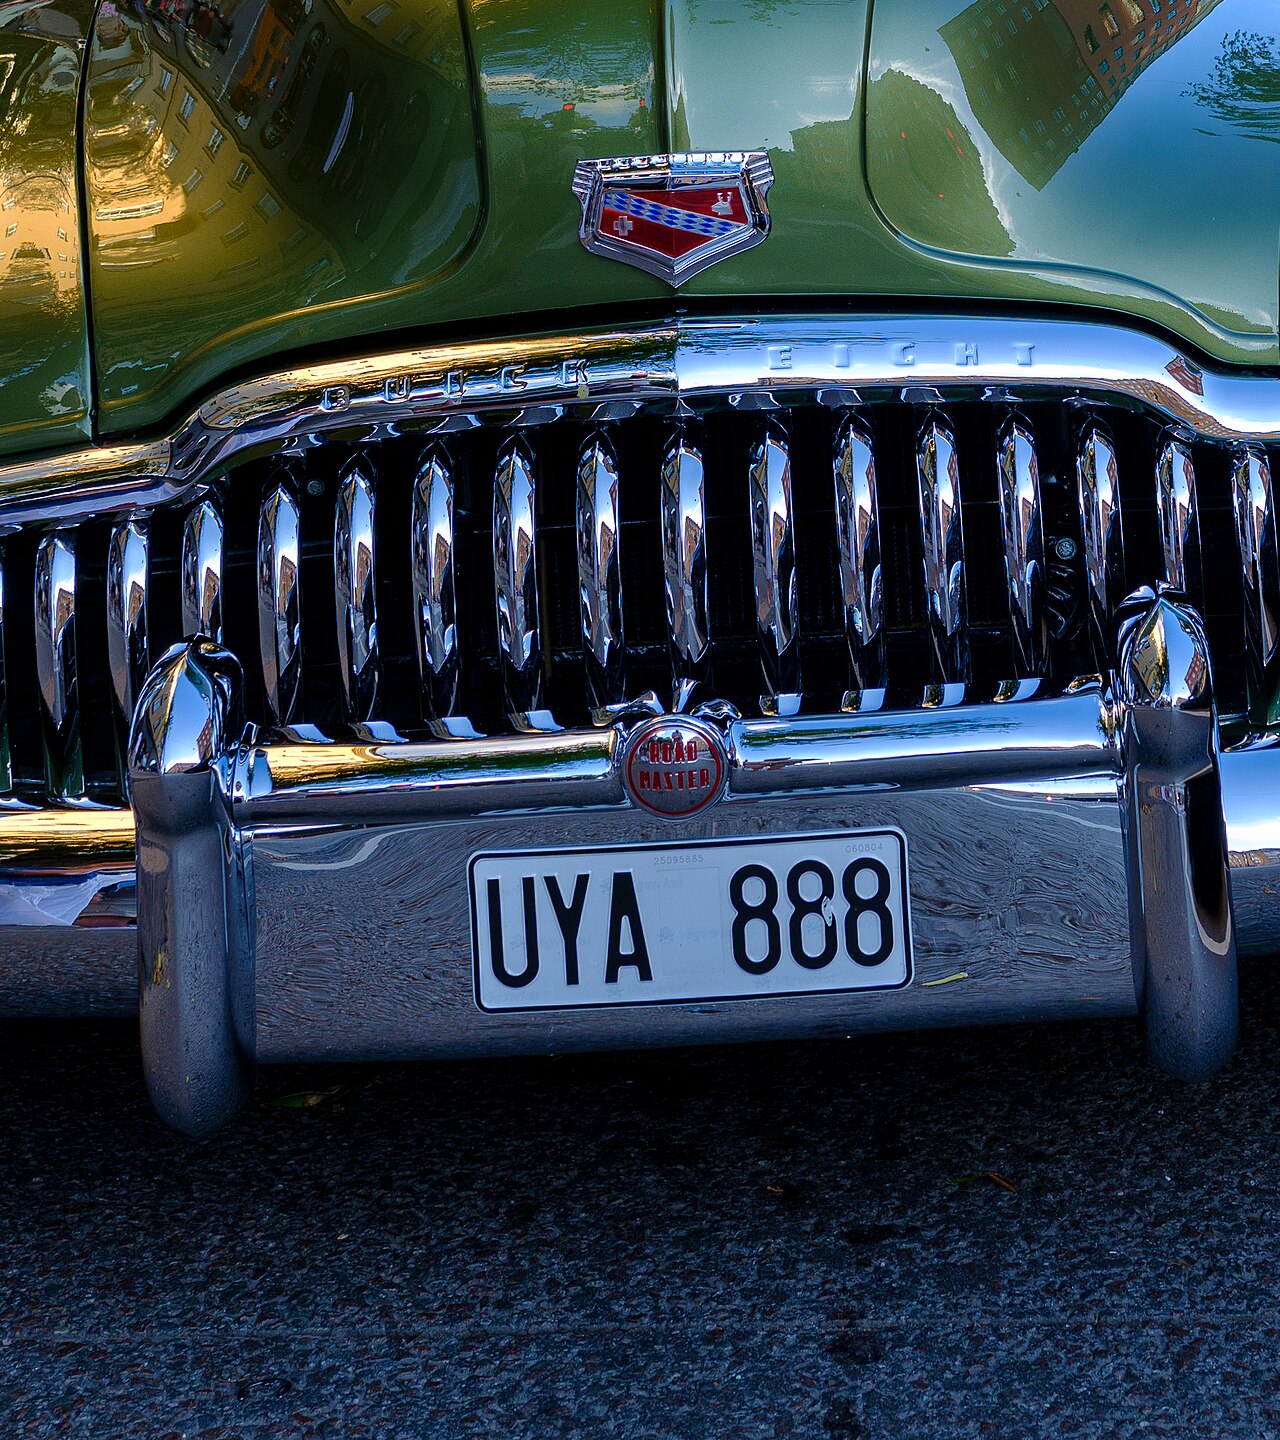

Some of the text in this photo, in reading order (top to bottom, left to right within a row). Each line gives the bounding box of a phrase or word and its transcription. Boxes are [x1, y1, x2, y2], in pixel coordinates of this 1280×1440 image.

[767, 342, 1036, 370] EIGHT
[648, 741, 698, 765] ROAD
[639, 768, 710, 791] MASTER
[653, 853, 705, 866] 25095885
[486, 856, 894, 989] UYA 888
